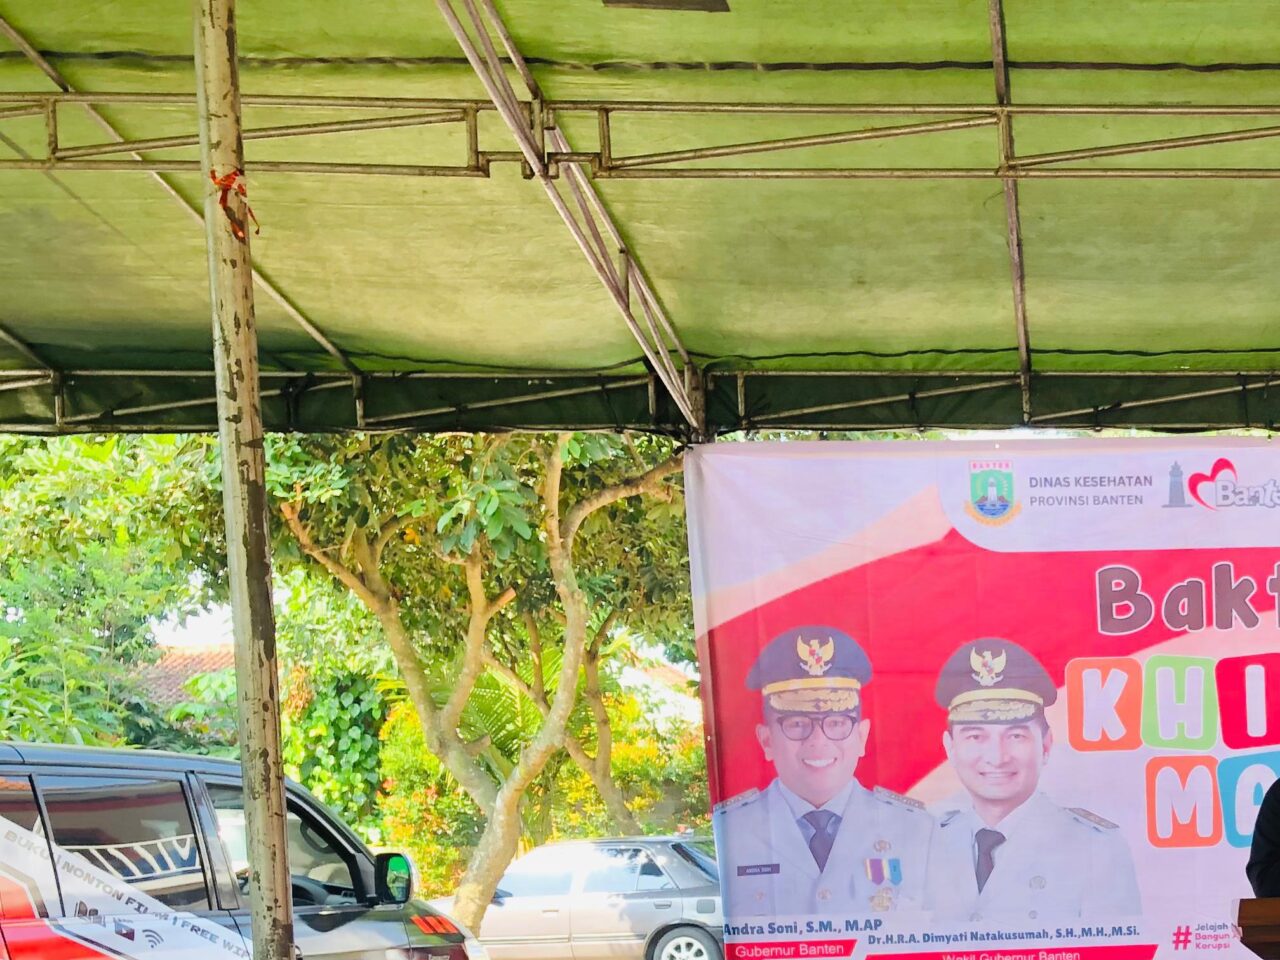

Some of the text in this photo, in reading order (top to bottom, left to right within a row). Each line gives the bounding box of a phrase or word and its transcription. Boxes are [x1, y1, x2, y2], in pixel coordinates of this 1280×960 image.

[1029, 475, 1152, 488] DINAS KESEHATAN
[1029, 494, 1143, 506] PROVINSI BANTEN
[4, 829, 50, 861] BUKU
[62, 861, 125, 902] NONTON
[181, 920, 219, 944] FREE
[724, 918, 882, 936] Andra Soni, S.M., M.AP
[1195, 923, 1229, 932] Jelajah
[868, 932, 920, 946] Dr.H.R.A.
[923, 931, 967, 945] Dimyati
[970, 928, 1053, 942] Natakusumah,
[736, 943, 844, 959] Gubernur Banten
[1195, 942, 1231, 951] Korupsi
